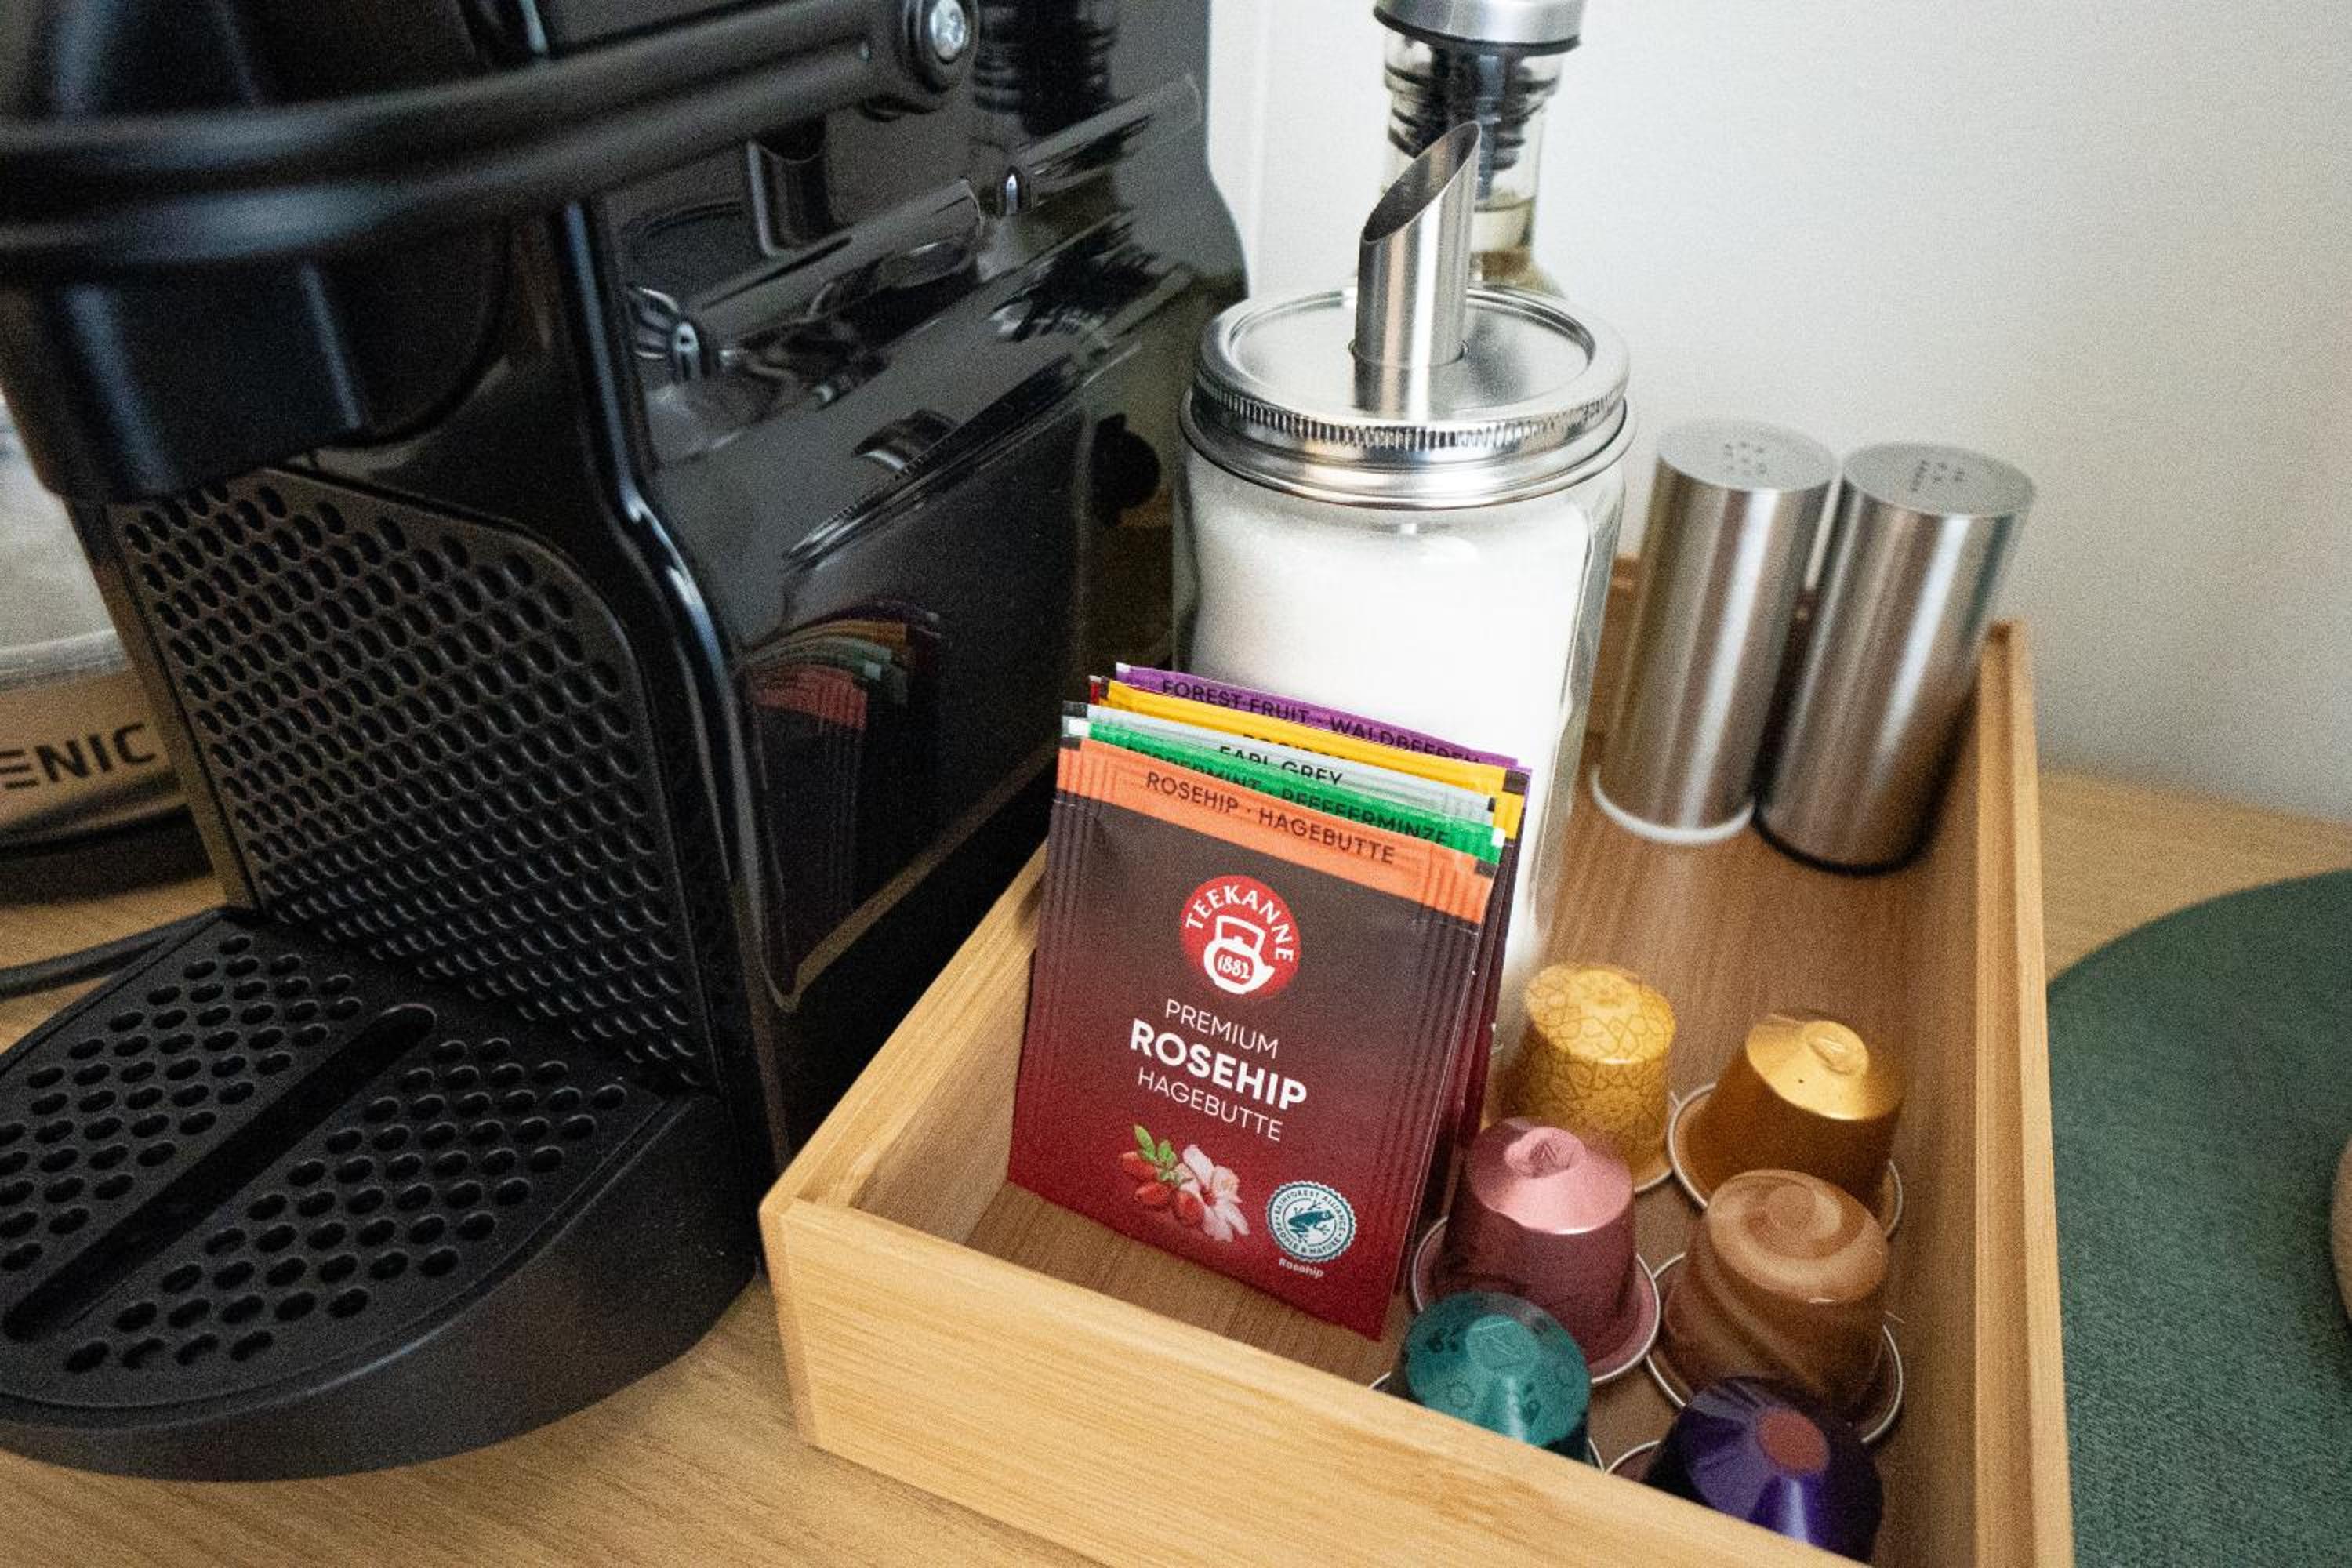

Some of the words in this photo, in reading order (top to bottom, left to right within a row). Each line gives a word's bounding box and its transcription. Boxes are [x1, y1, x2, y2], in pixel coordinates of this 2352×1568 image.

[1162, 679, 1242, 709] FOREST
[1249, 698, 1310, 724] FRUIT
[1281, 760, 1344, 785] GREY
[1146, 771, 1239, 813] ROSEHIP
[1258, 807, 1395, 864] HAGEBUTTE
[1185, 885, 1294, 963] TEEKANNE
[1218, 954, 1250, 979] 1882
[1165, 998, 1279, 1059] PREMIUM
[1130, 1018, 1307, 1110] ROSEHIP
[1138, 1066, 1283, 1142] HAGEBUTTE
[1275, 1189, 1319, 1214] RAINFOREST
[1322, 1196, 1347, 1232] ALLIANCE
[1276, 1222, 1299, 1250] PEOPLE
[1309, 1236, 1341, 1254] NATURE
[1278, 1258, 1325, 1279] Rosehip
